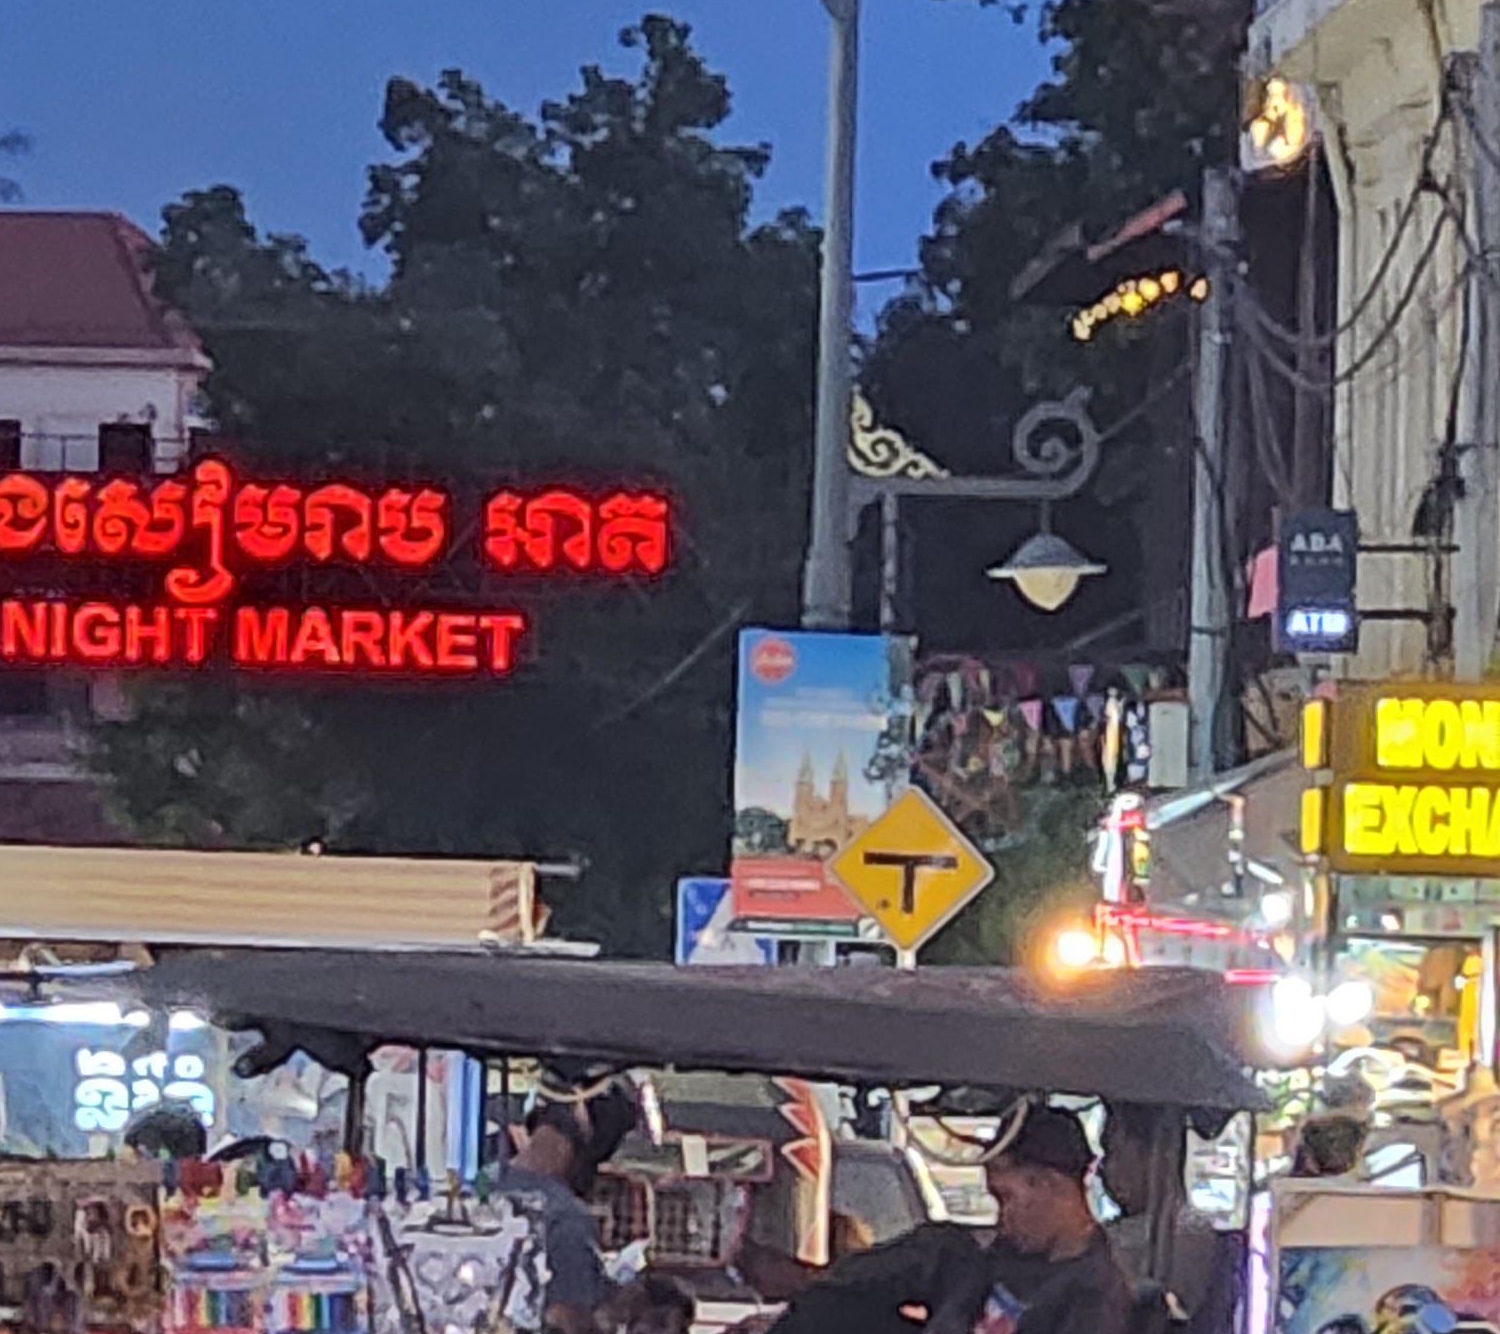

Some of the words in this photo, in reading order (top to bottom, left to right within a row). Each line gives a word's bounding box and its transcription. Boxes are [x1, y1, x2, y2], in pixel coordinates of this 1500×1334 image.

[2, 600, 218, 663] NIGHT
[235, 609, 523, 671] MARKET
[1287, 609, 1348, 634] ATM
